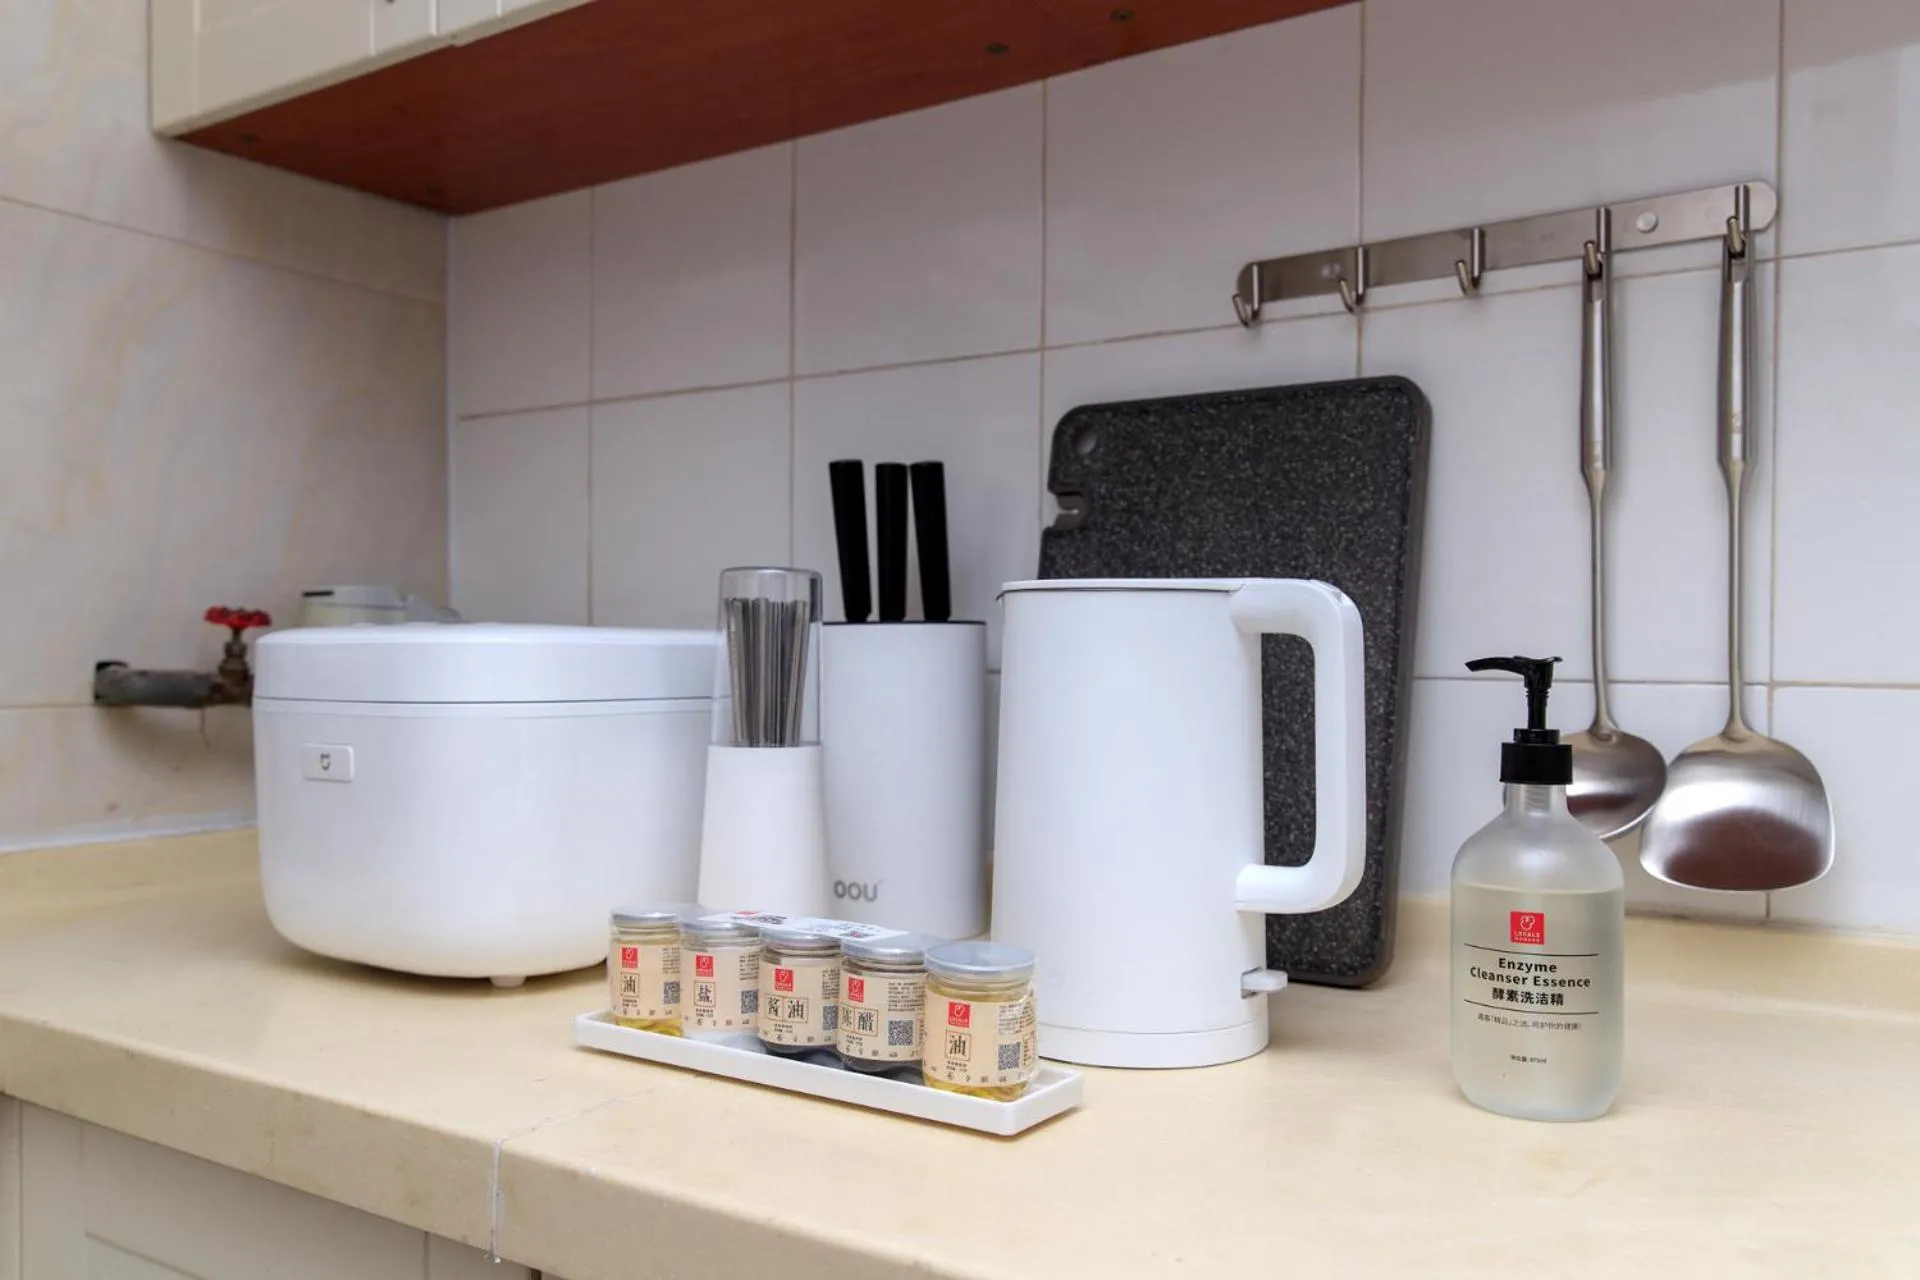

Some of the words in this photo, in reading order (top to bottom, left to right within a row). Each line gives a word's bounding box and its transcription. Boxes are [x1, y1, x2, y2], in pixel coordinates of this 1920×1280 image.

[1498, 958, 1558, 973] Enzyme
[622, 975, 637, 995] 油
[1470, 967, 1528, 985] Cleanser
[1533, 976, 1591, 988] Essence
[697, 984, 713, 1003] 盐
[1492, 987, 1565, 1006] 酵素洗洁精
[766, 998, 805, 1020] 酱油
[948, 1035, 966, 1058] 油
